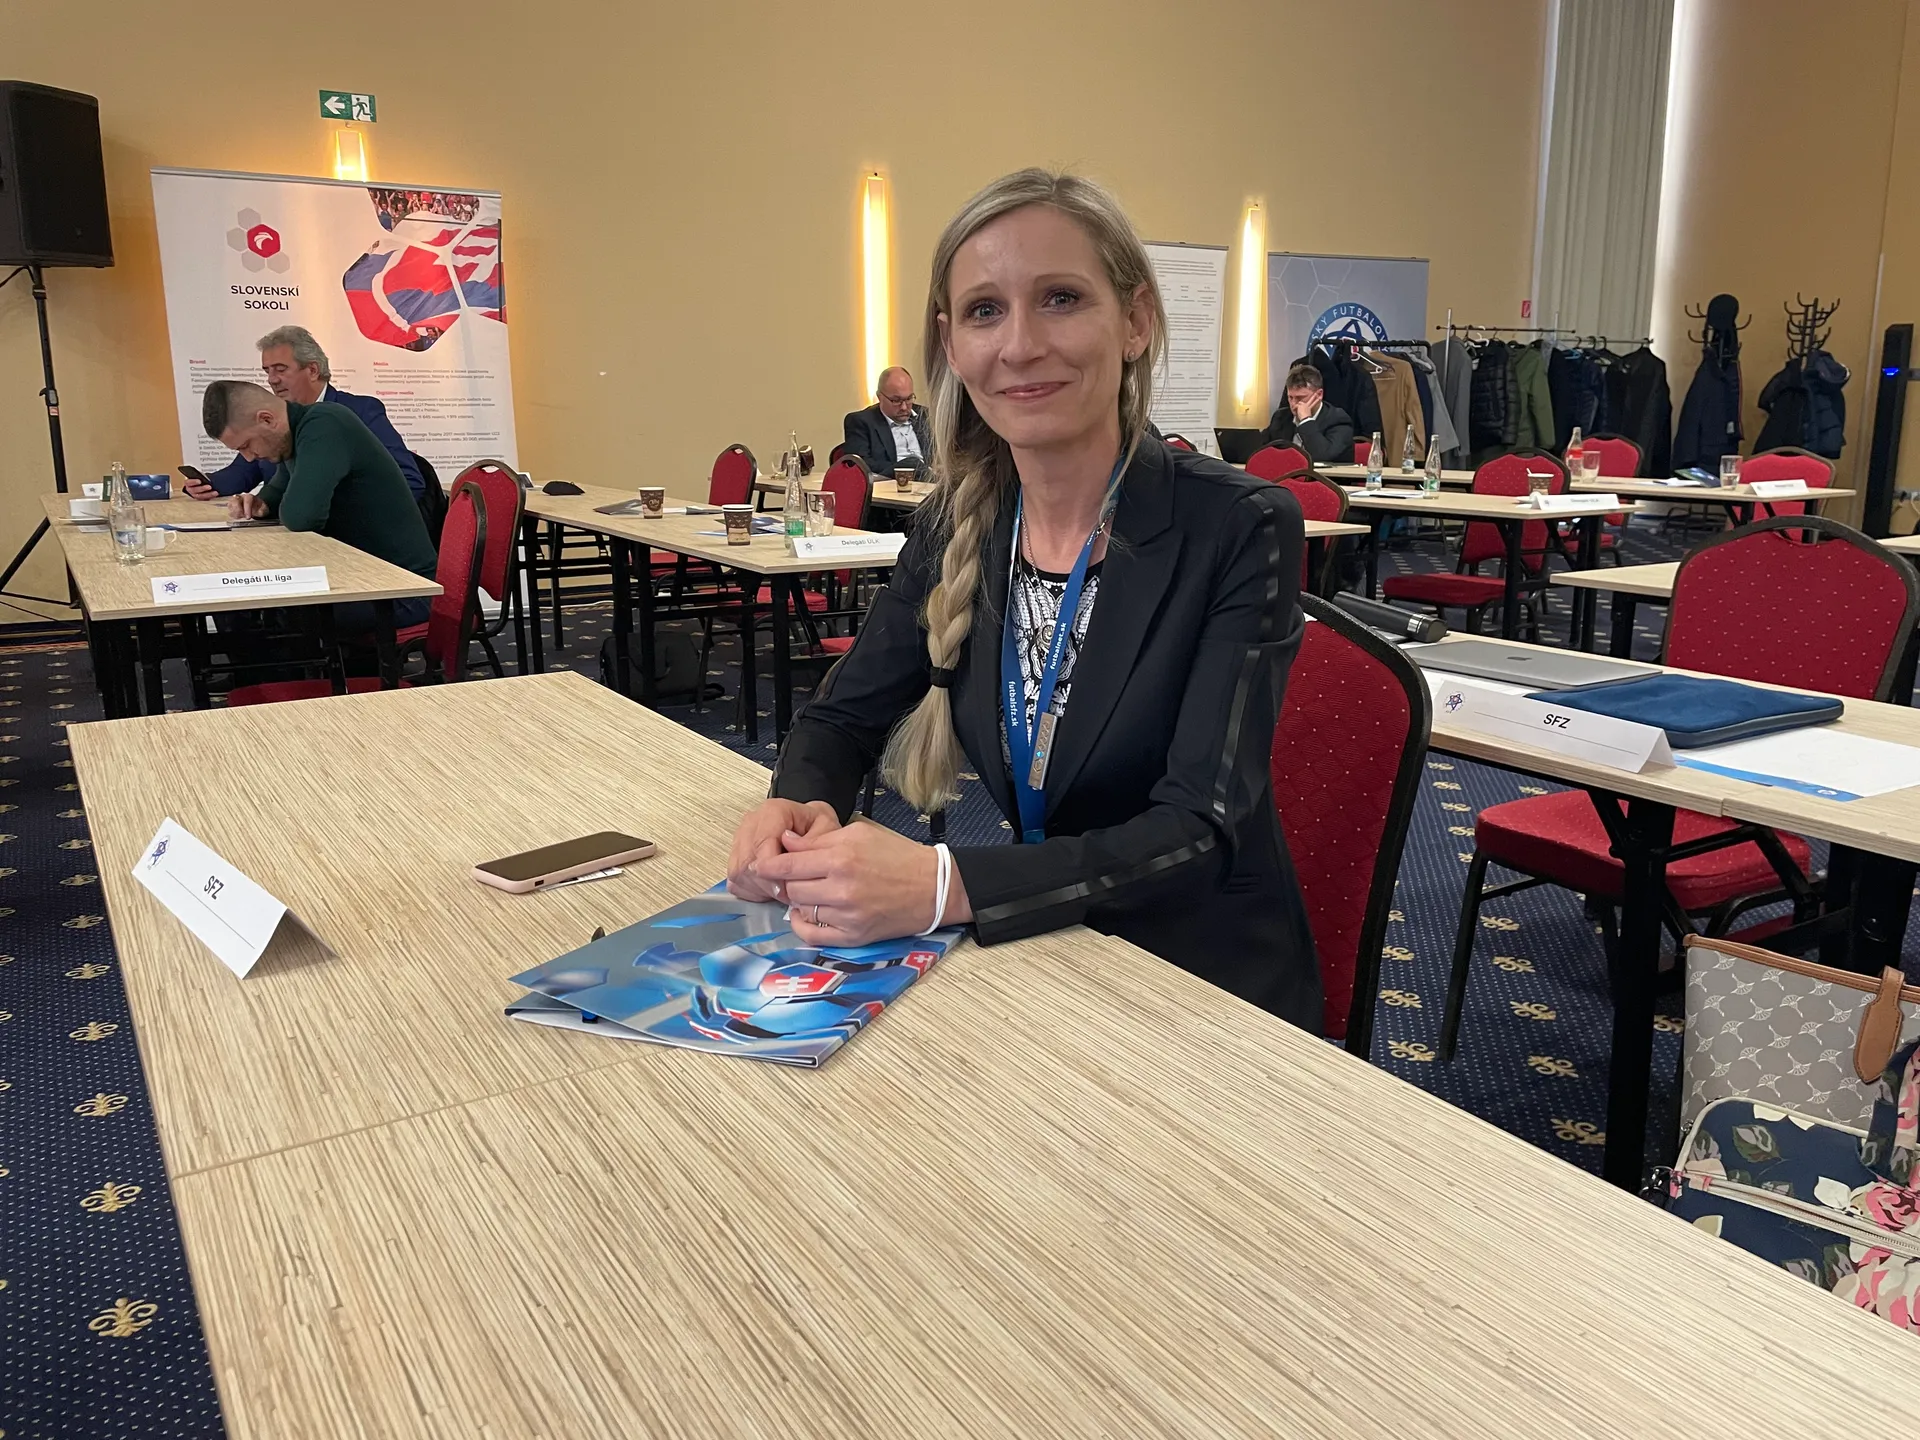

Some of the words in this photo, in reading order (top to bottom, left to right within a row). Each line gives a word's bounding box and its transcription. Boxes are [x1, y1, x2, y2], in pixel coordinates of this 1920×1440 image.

[230, 284, 300, 297] SLOVENSKÍ
[244, 300, 289, 311] SOKOLI
[222, 575, 262, 585] Delegáti
[275, 574, 292, 582] liga
[1049, 622, 1067, 670] futbalnet.sk
[1008, 680, 1019, 727] futbalsfz.sk
[1543, 713, 1571, 729] SFZ
[203, 875, 225, 900] SFZ
